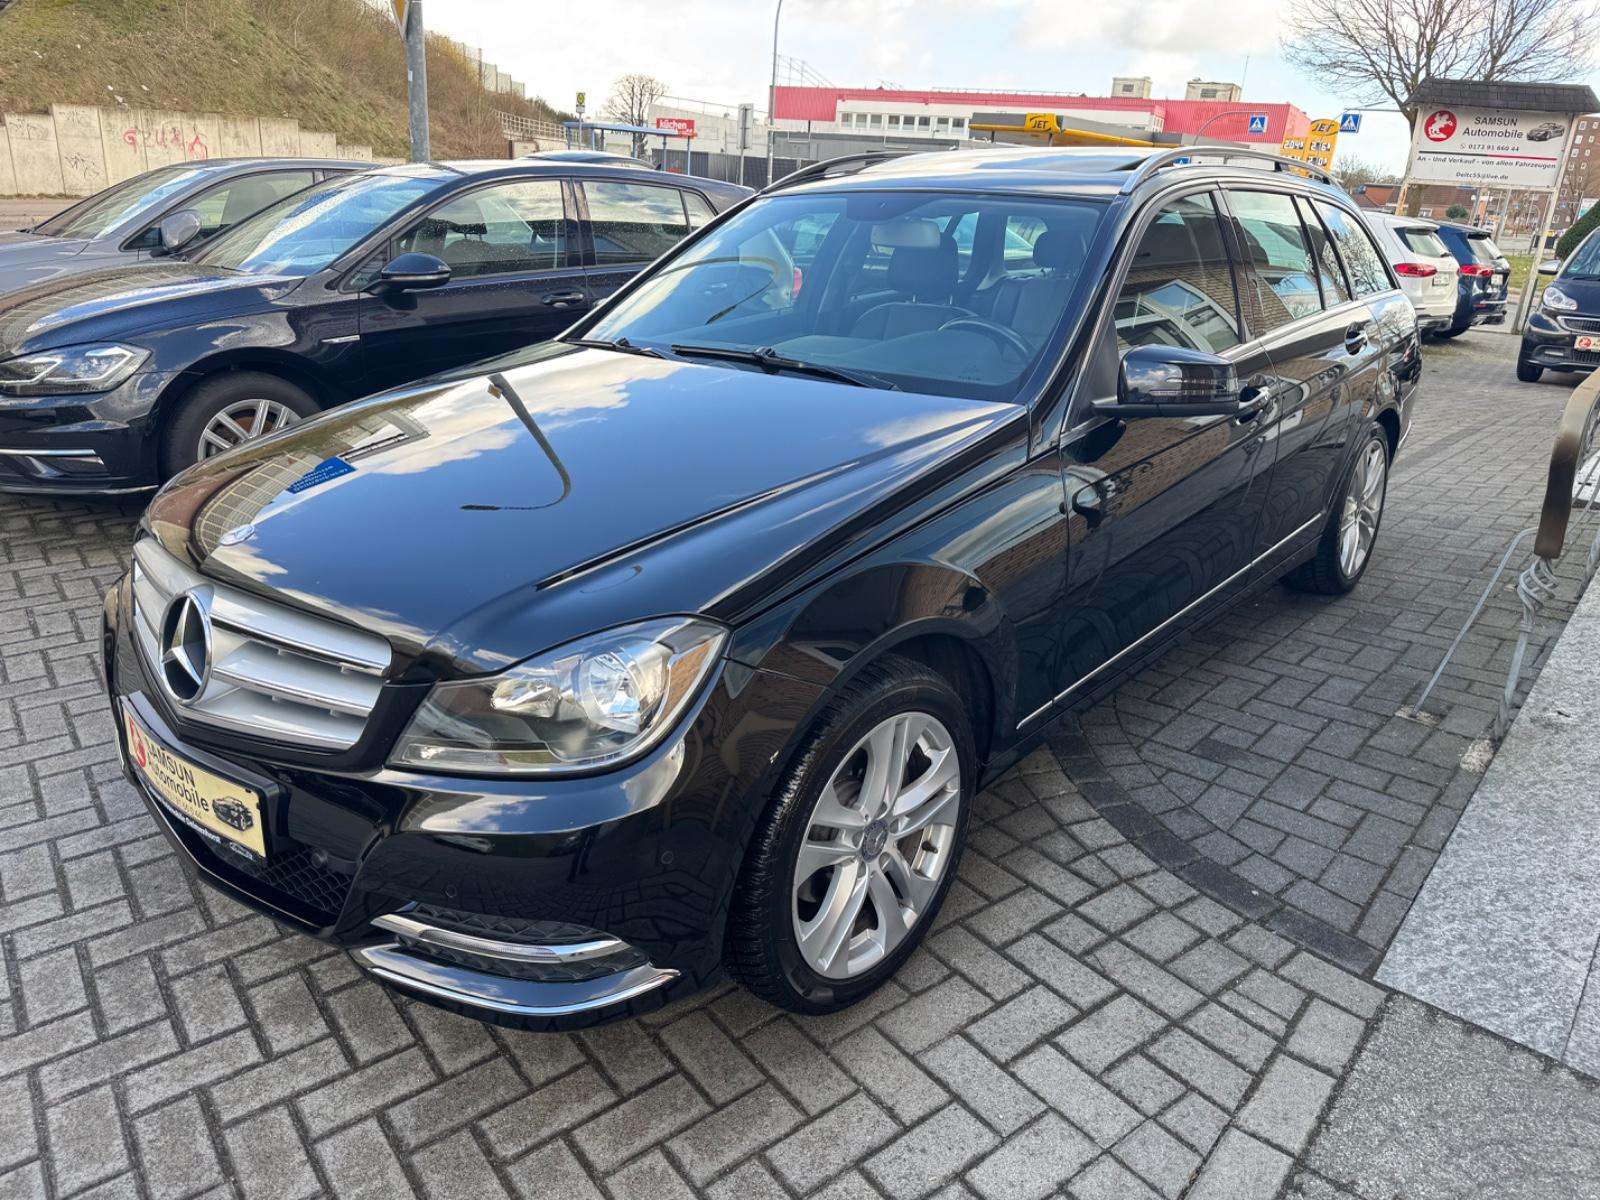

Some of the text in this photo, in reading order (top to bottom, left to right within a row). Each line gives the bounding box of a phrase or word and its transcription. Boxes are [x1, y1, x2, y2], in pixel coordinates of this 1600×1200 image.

[659, 119, 687, 129] küchen
[1032, 120, 1048, 128] JET
[1474, 116, 1518, 126] SAMSUN
[1312, 123, 1334, 132] JET
[1462, 127, 1523, 138] Automobile
[1514, 161, 1556, 169] Fahrzeugen
